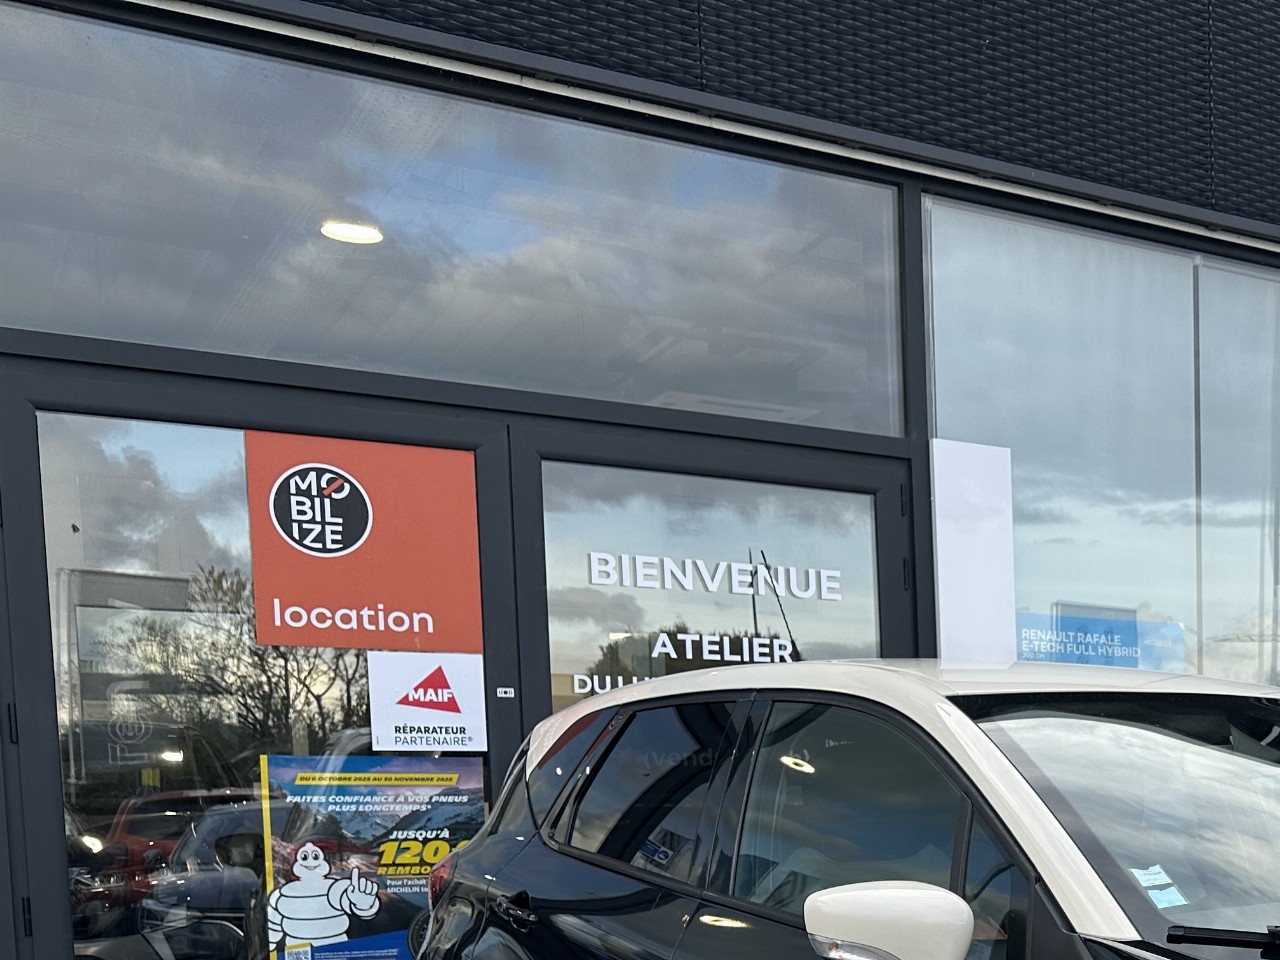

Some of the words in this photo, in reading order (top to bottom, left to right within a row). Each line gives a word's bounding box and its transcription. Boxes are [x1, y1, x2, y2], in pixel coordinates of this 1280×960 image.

[588, 551, 842, 601] BIENVENUE
[273, 597, 434, 634] location
[1021, 628, 1076, 644] RENAULT
[1077, 632, 1122, 646] RAFALE
[651, 632, 794, 664] ATELIER
[1021, 640, 1065, 653] E-TECH
[1066, 643, 1096, 656] FULL
[1098, 645, 1142, 658] HYBRID
[573, 673, 612, 694] DU
[408, 688, 454, 703] MAIF
[394, 723, 467, 735] RÉPARATEUR
[285, 795, 327, 803] FAITES
[328, 795, 396, 803] CONFIANCE
[407, 795, 430, 803] VOS
[431, 795, 469, 803] PNEUS
[327, 804, 357, 812] PLUS
[376, 866, 431, 876] REMBO
